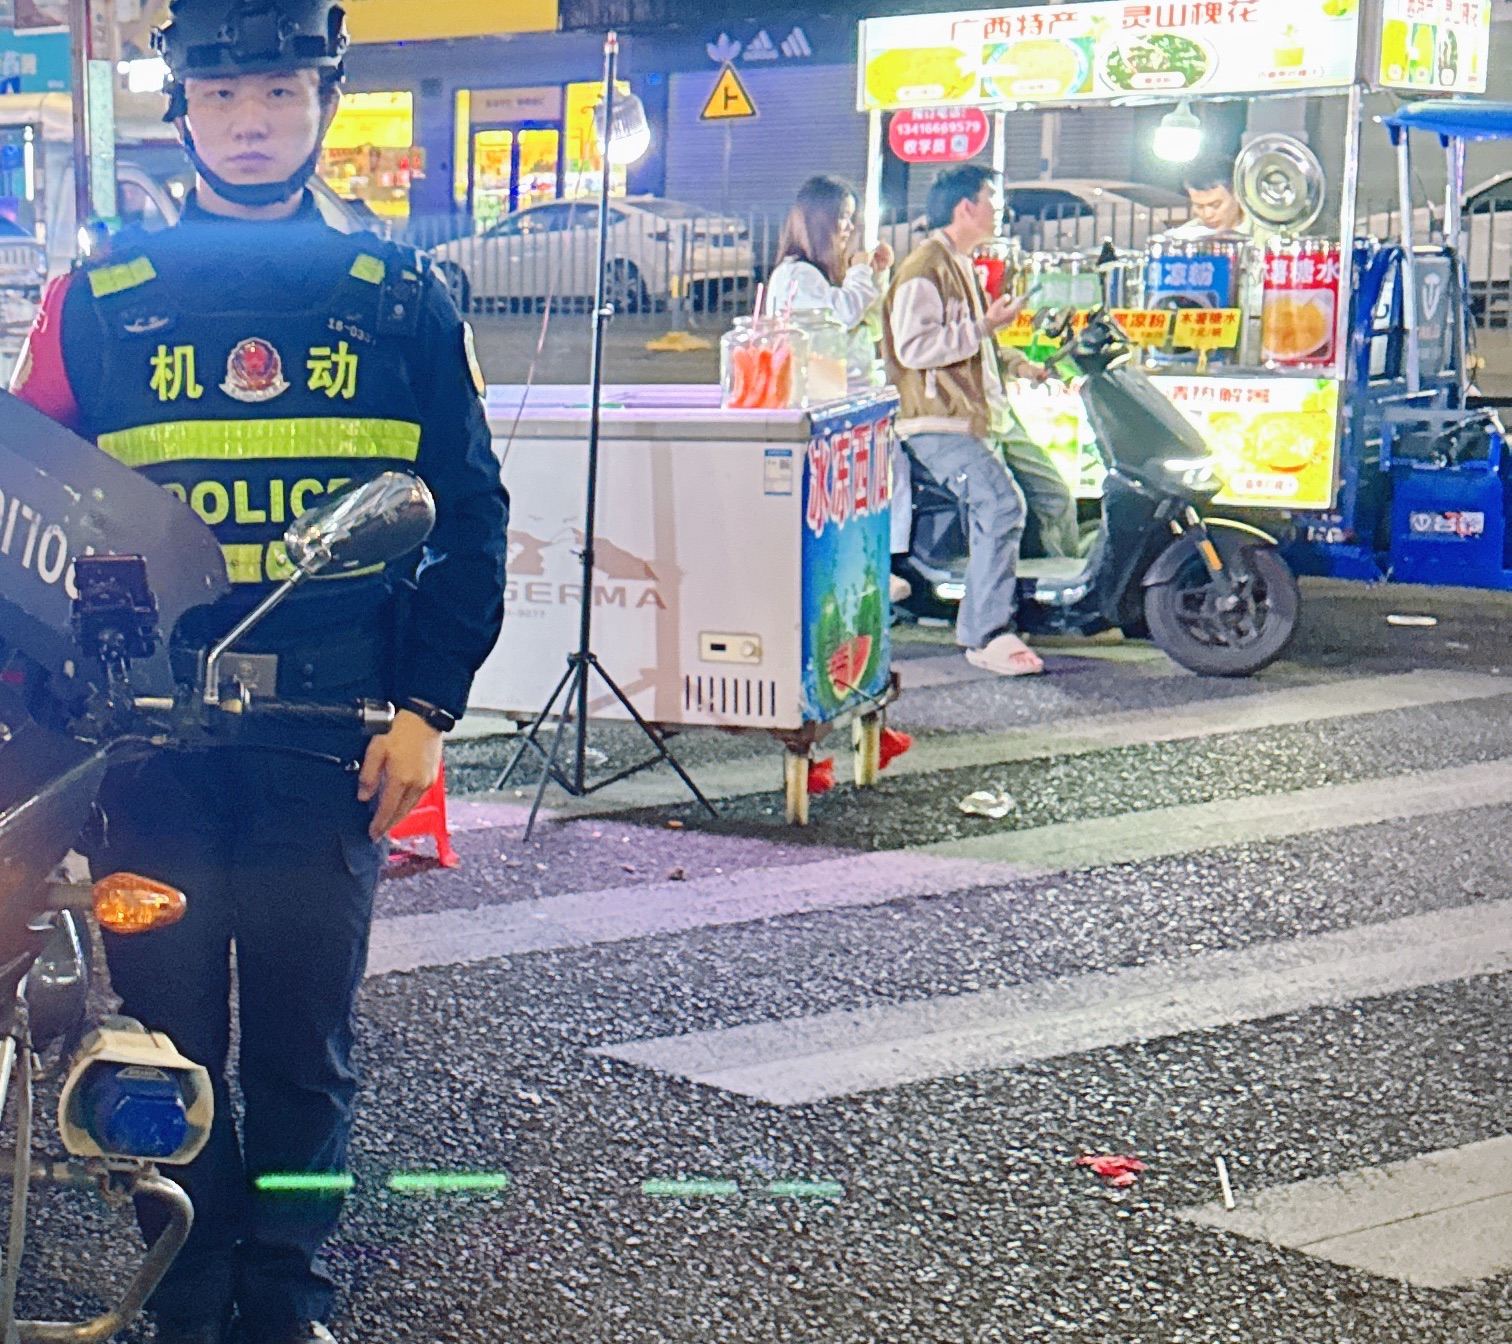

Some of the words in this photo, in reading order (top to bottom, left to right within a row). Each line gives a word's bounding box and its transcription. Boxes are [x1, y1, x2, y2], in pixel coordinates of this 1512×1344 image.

[949, 11, 1079, 42] 广西特产
[1264, 258, 1341, 286] 薯糖水
[149, 344, 204, 401] 机
[306, 340, 359, 400] 动
[161, 477, 352, 525] OLIC
